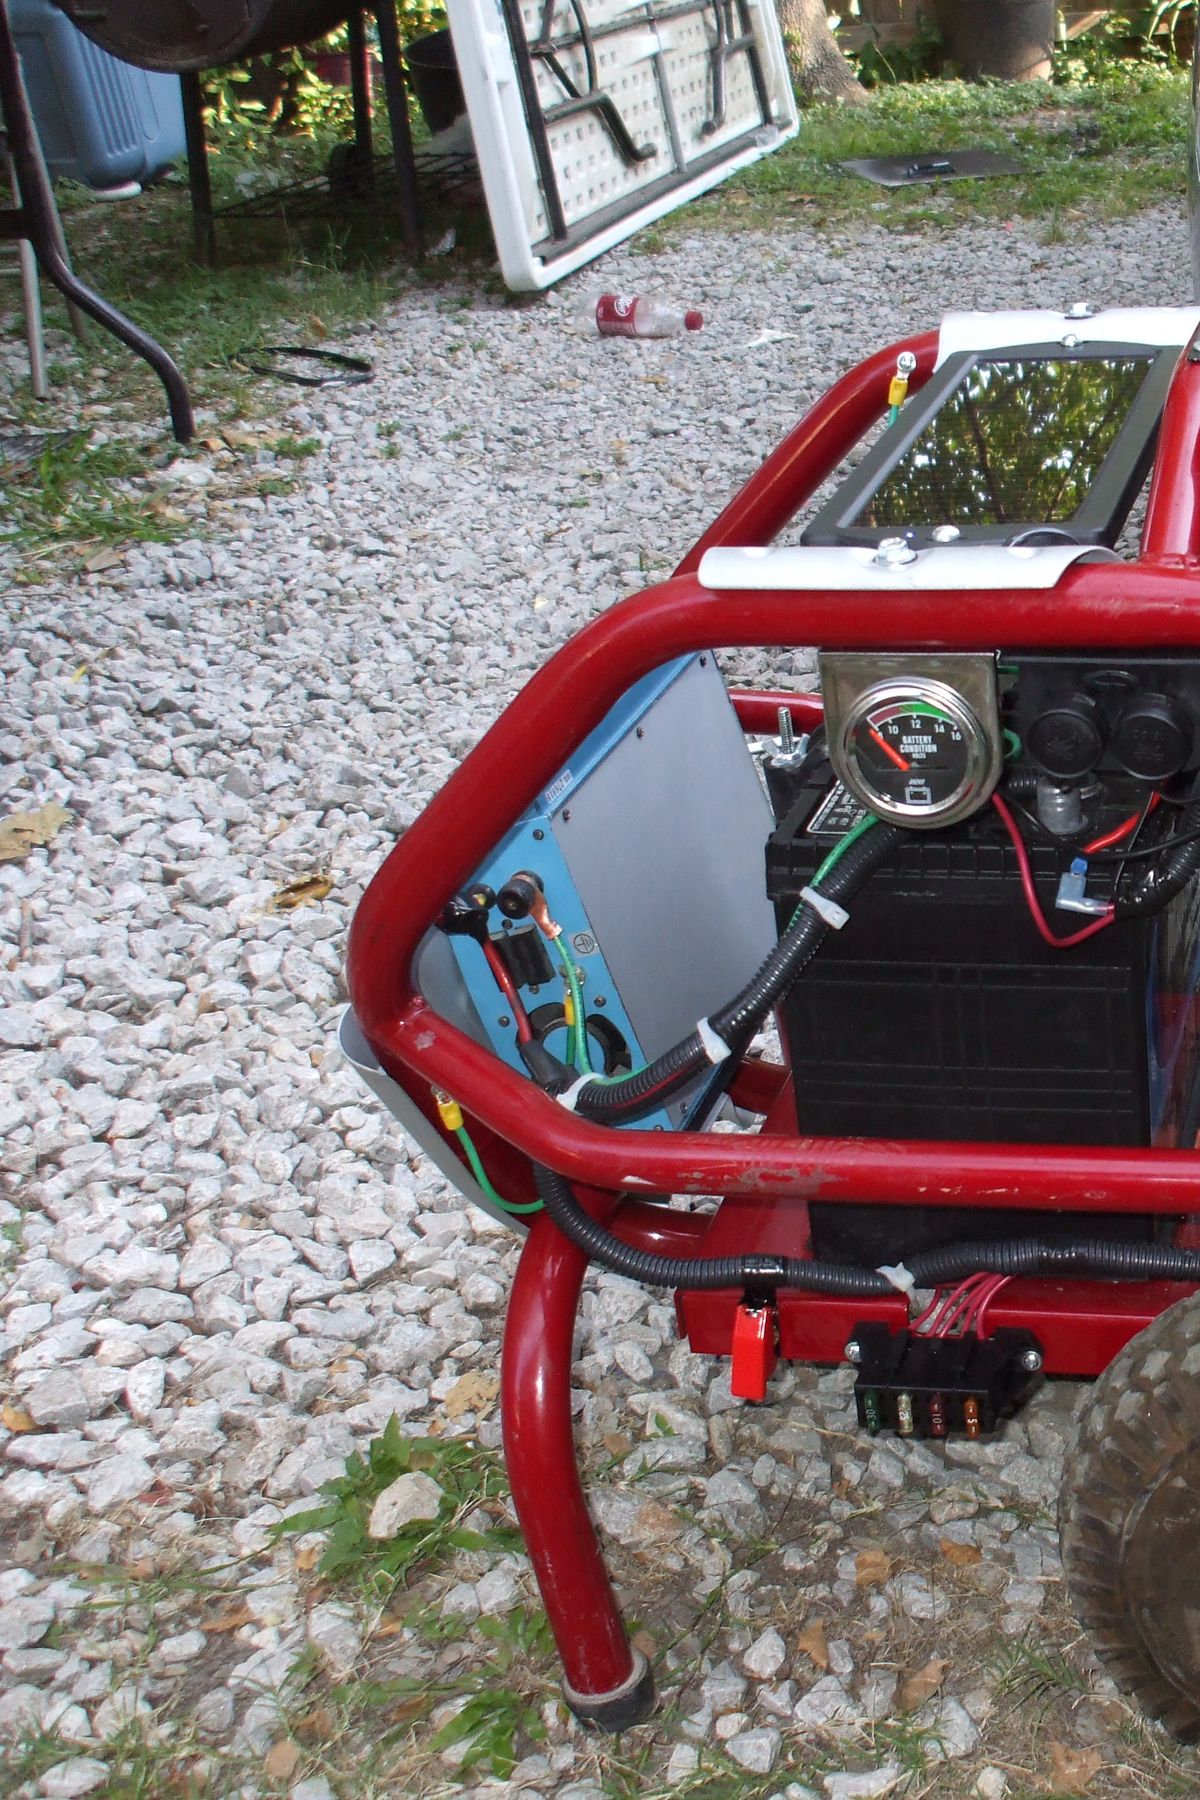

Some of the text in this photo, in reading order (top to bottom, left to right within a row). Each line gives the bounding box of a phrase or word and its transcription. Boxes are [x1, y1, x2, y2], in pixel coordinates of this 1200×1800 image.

[888, 725, 899, 734] 10
[911, 720, 922, 729] 12
[934, 724, 945, 733] 14
[951, 732, 962, 741] 16
[902, 735, 933, 744] BATTERY
[899, 744, 938, 753] CONDITION
